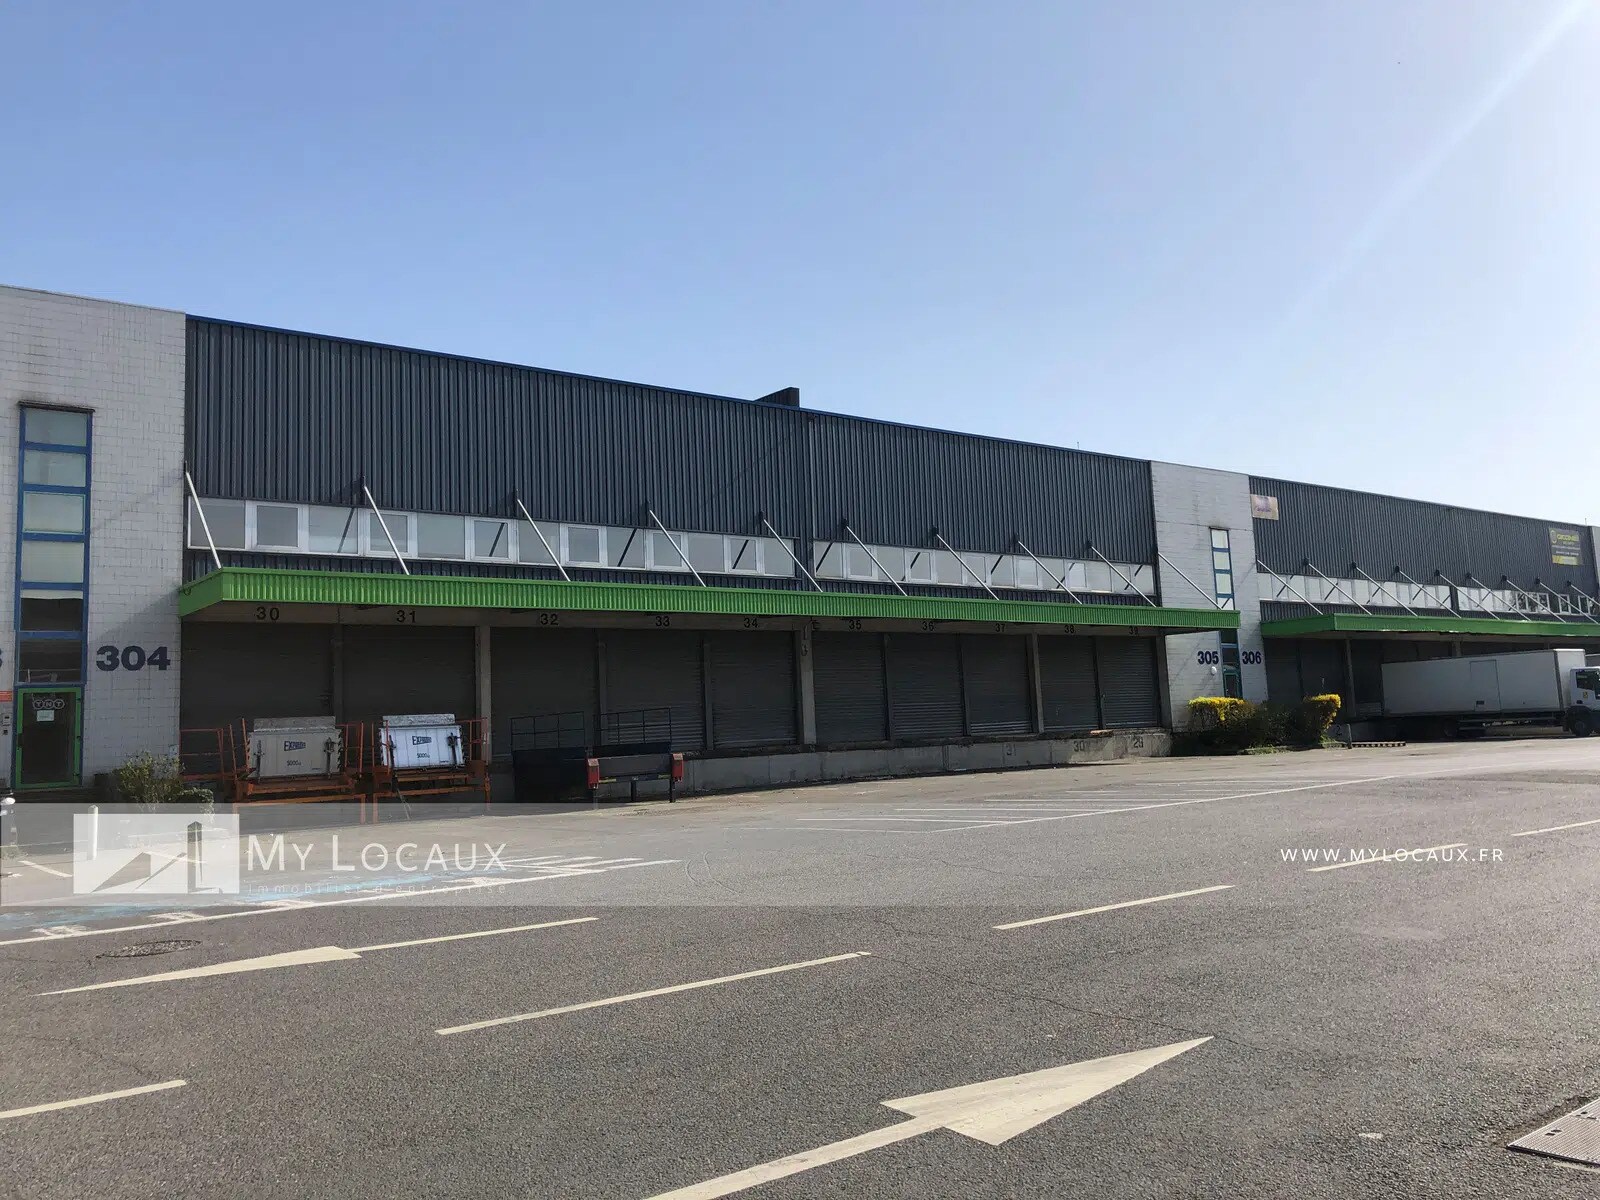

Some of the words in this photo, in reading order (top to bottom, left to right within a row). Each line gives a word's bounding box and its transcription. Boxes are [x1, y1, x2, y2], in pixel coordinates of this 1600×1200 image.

[256, 606, 280, 621] 30
[396, 610, 417, 623] 31
[540, 613, 559, 626] 32
[655, 615, 671, 627] 33
[743, 617, 759, 628] 34
[849, 619, 862, 630] 35
[922, 620, 934, 632] 36
[995, 623, 1006, 633] 37
[96, 645, 171, 671] 304
[1197, 650, 1219, 665] 305
[1242, 650, 1262, 665] 306
[33, 699, 65, 710] TNT
[1073, 740, 1085, 752] 30
